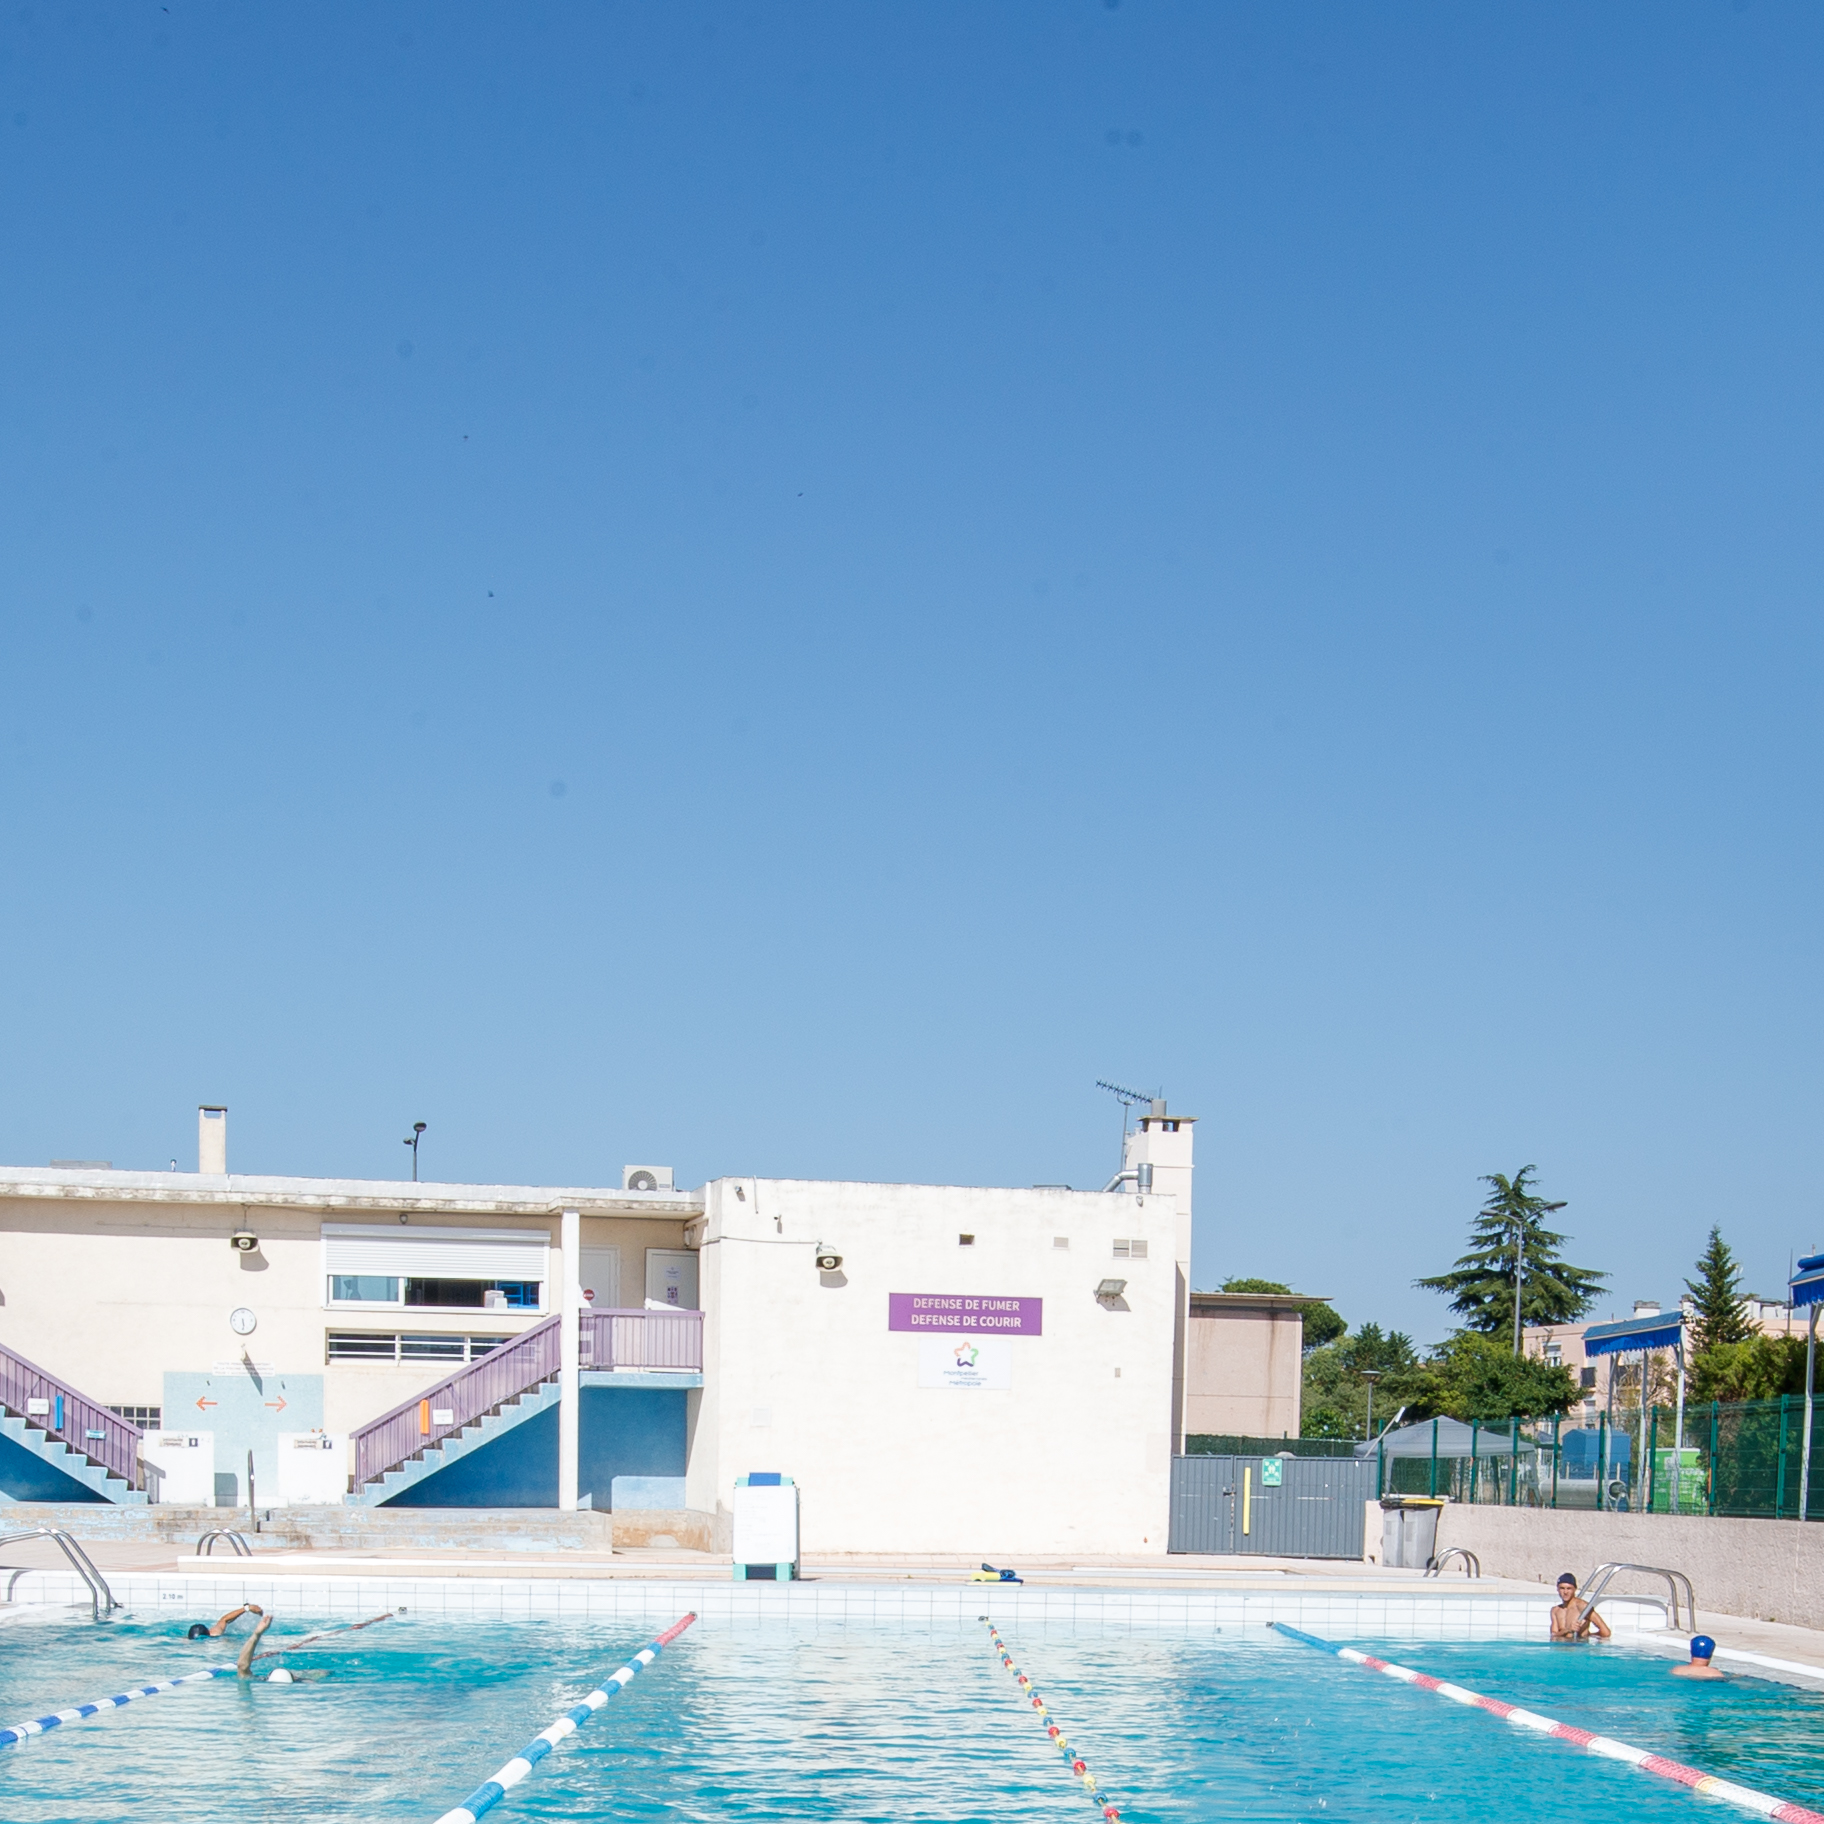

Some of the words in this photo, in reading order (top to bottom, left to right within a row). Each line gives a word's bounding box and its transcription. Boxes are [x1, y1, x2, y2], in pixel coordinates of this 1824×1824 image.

[913, 1297, 963, 1310] DEFENSE
[965, 1299, 980, 1310] DE
[982, 1300, 1020, 1311] FUMER
[911, 1314, 961, 1326] DEFENSE
[963, 1316, 978, 1327] DE
[979, 1316, 1022, 1328] COURIR
